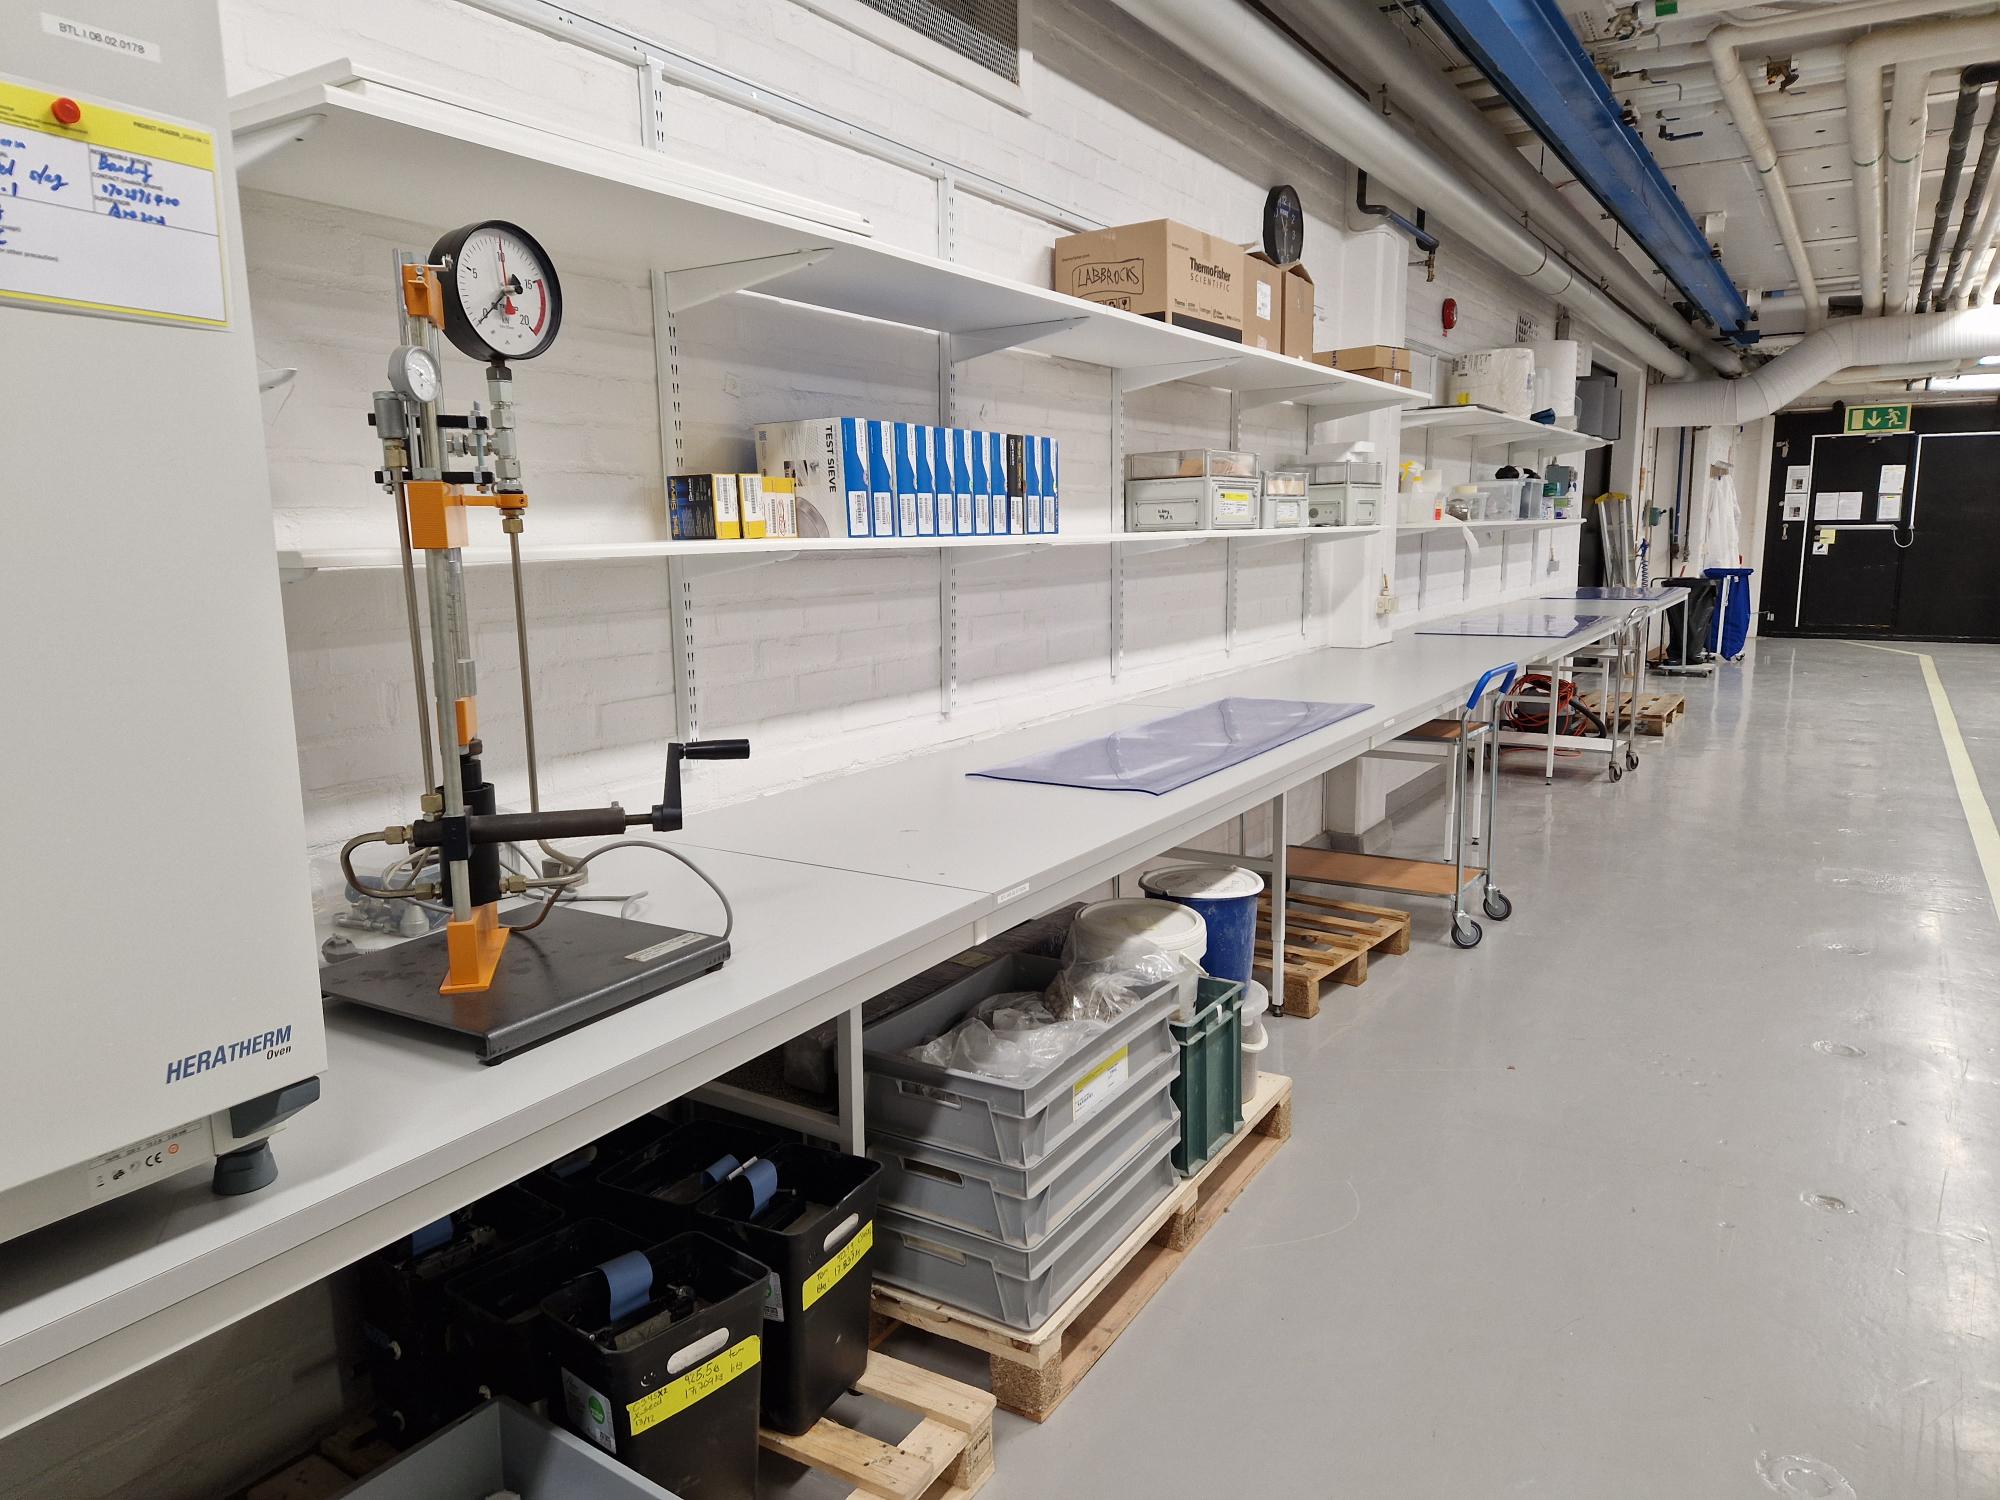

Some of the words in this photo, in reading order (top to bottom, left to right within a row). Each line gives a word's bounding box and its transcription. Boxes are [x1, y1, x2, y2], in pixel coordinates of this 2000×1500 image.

[472, 268, 478, 279] 5
[1078, 266, 1140, 288] LABBROCKS
[1189, 256, 1232, 282] ThermoFisher
[524, 279, 533, 290] 15
[1190, 274, 1231, 293] SCIENTIFIC
[520, 314, 530, 326] 20
[825, 425, 834, 455] TEST
[827, 458, 837, 493] SIEVE
[166, 1025, 292, 1084] HERATHERM
[266, 1045, 292, 1060] Oven
